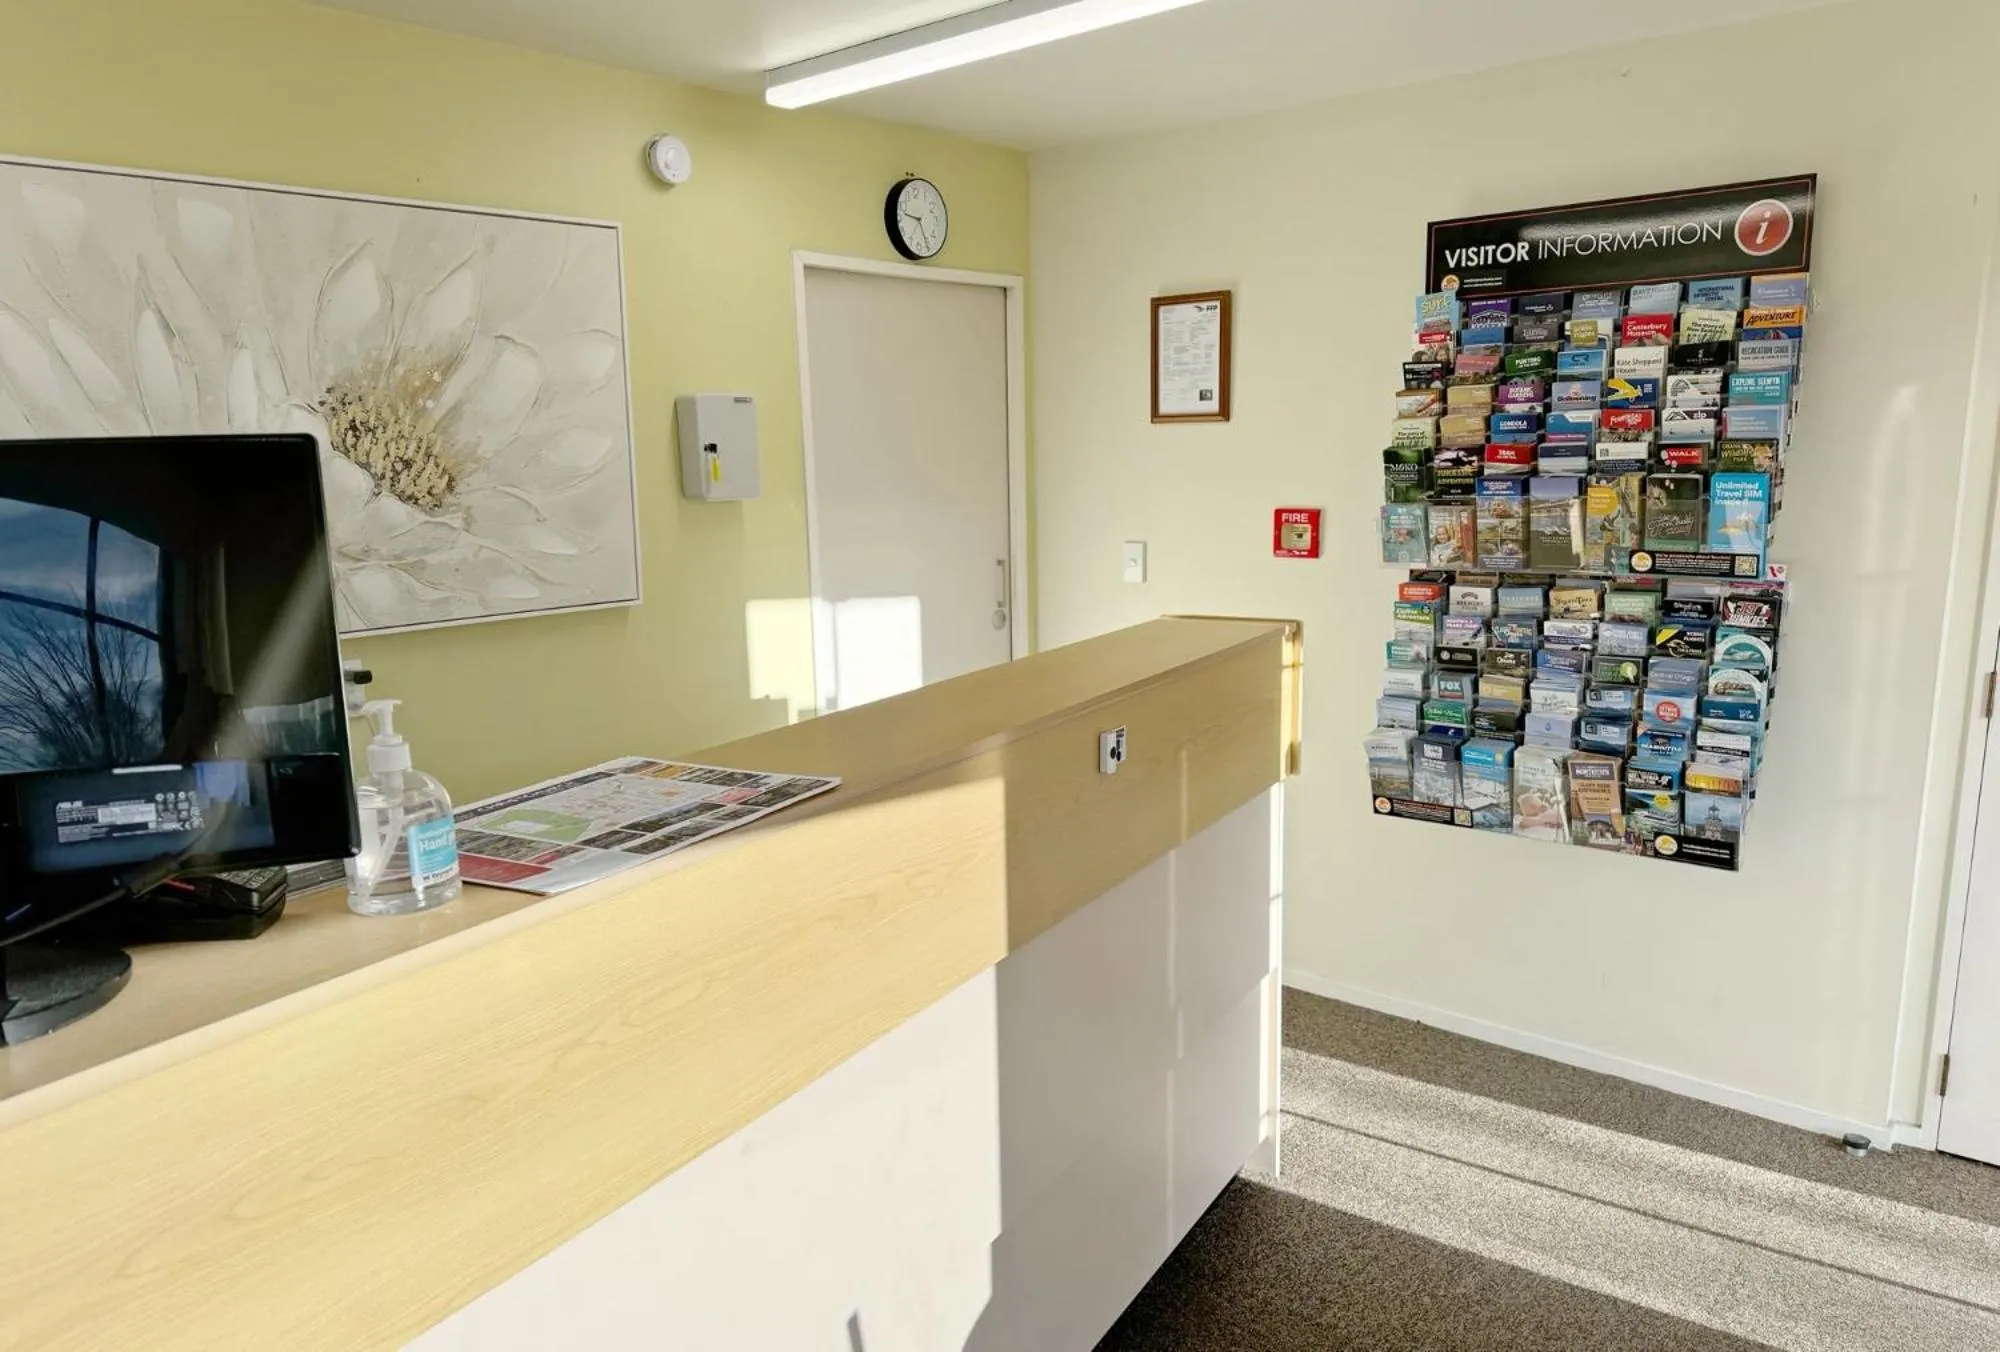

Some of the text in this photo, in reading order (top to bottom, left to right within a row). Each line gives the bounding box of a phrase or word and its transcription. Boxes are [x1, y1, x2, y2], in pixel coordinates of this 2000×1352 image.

[1445, 240, 1529, 268] VISITOR
[1538, 219, 1722, 260] INFORMATION
[1746, 311, 1796, 326] ADVENTURE
[1627, 322, 1668, 332] Canterbury
[1669, 449, 1698, 457] WALK
[1715, 481, 1760, 490] Unlimited
[1716, 489, 1763, 498] Travel SIM
[1281, 512, 1309, 523] FIRE
[1439, 680, 1461, 691] FOX
[418, 832, 447, 852] Hand
